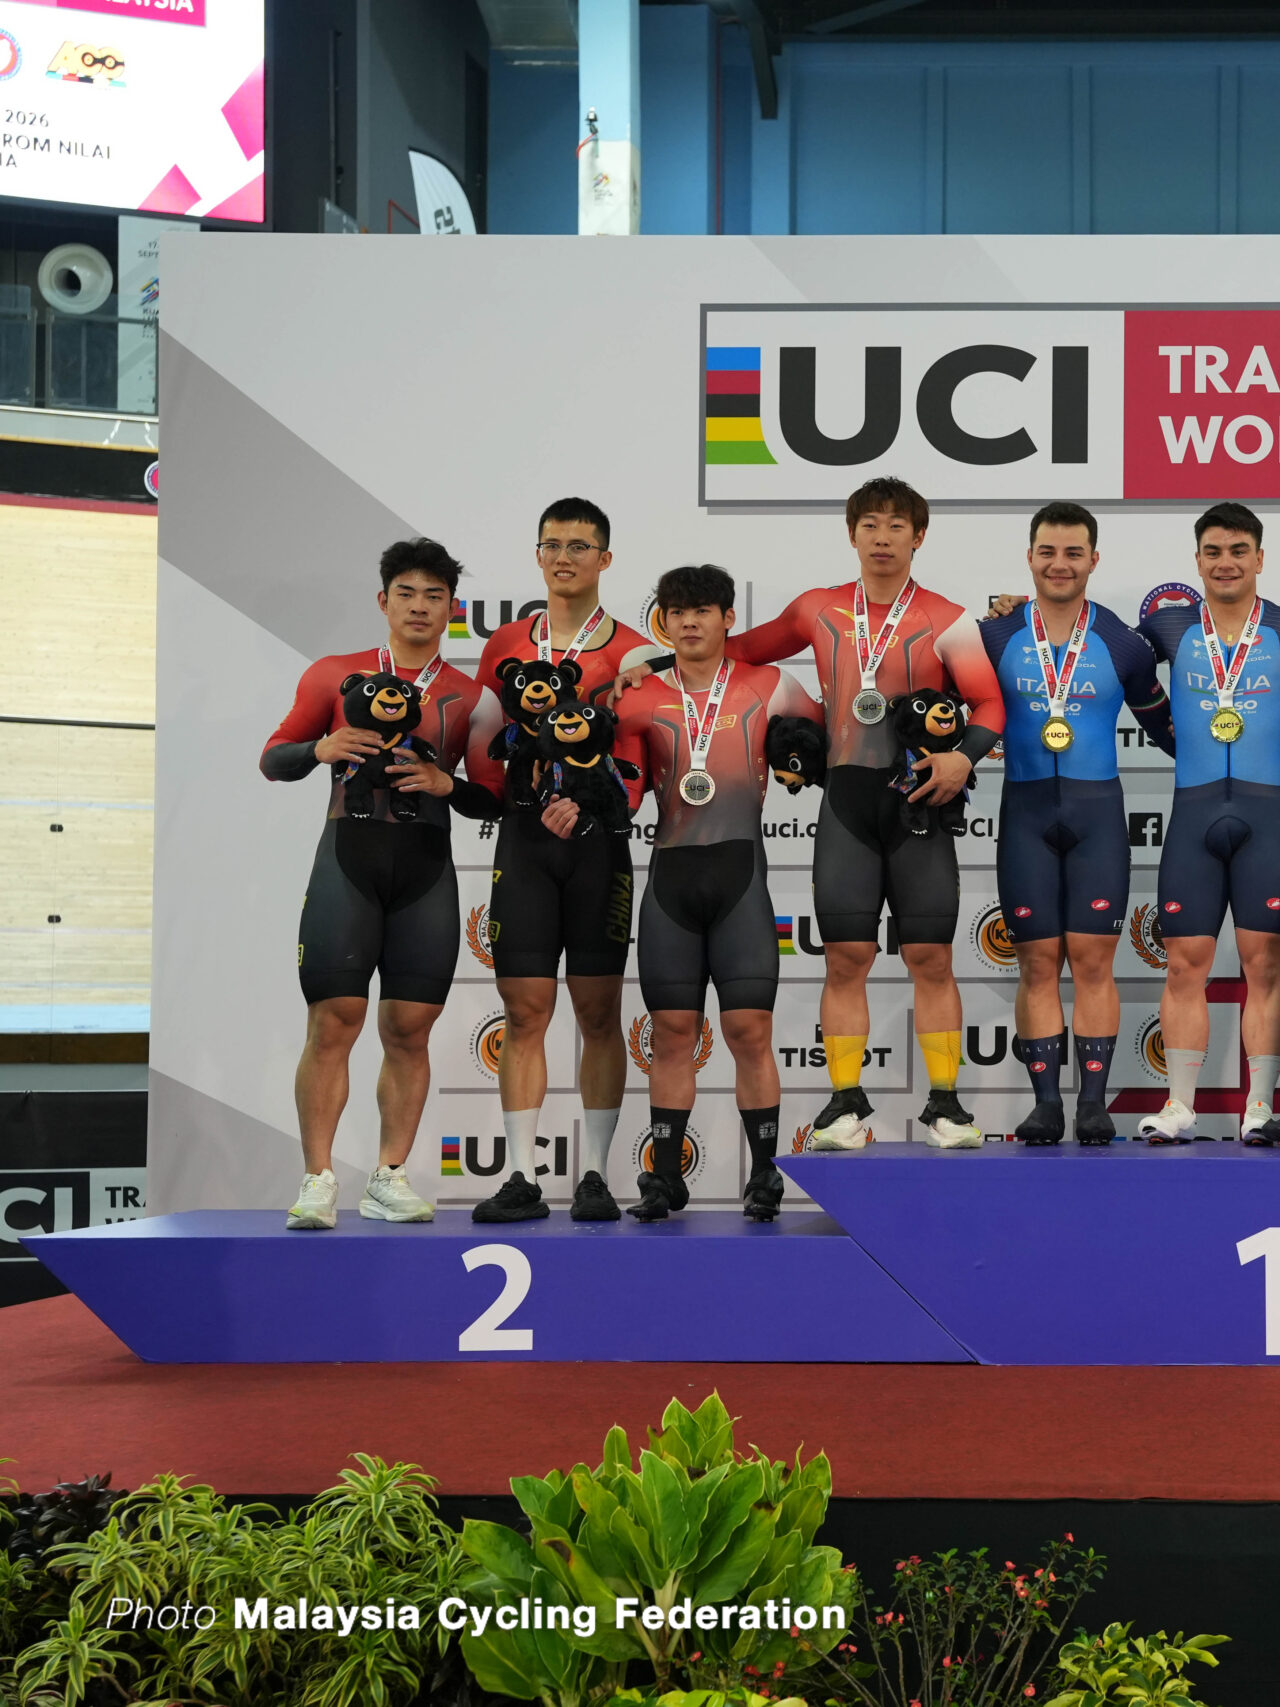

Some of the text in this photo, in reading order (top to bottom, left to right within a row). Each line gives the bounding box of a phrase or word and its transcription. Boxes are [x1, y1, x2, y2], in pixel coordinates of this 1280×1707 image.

[5, 109, 49, 127] 2026
[3, 133, 111, 159] ROM NILAI
[780, 345, 1089, 467] UCI
[1016, 677, 1097, 694] ITAIA
[1186, 671, 1271, 690] ITAIA
[1029, 701, 1082, 712] evso
[1200, 699, 1258, 711] evso
[1145, 910, 1157, 937] MAJLIS
[0, 1187, 73, 1243] CI
[459, 1244, 535, 1353] 2
